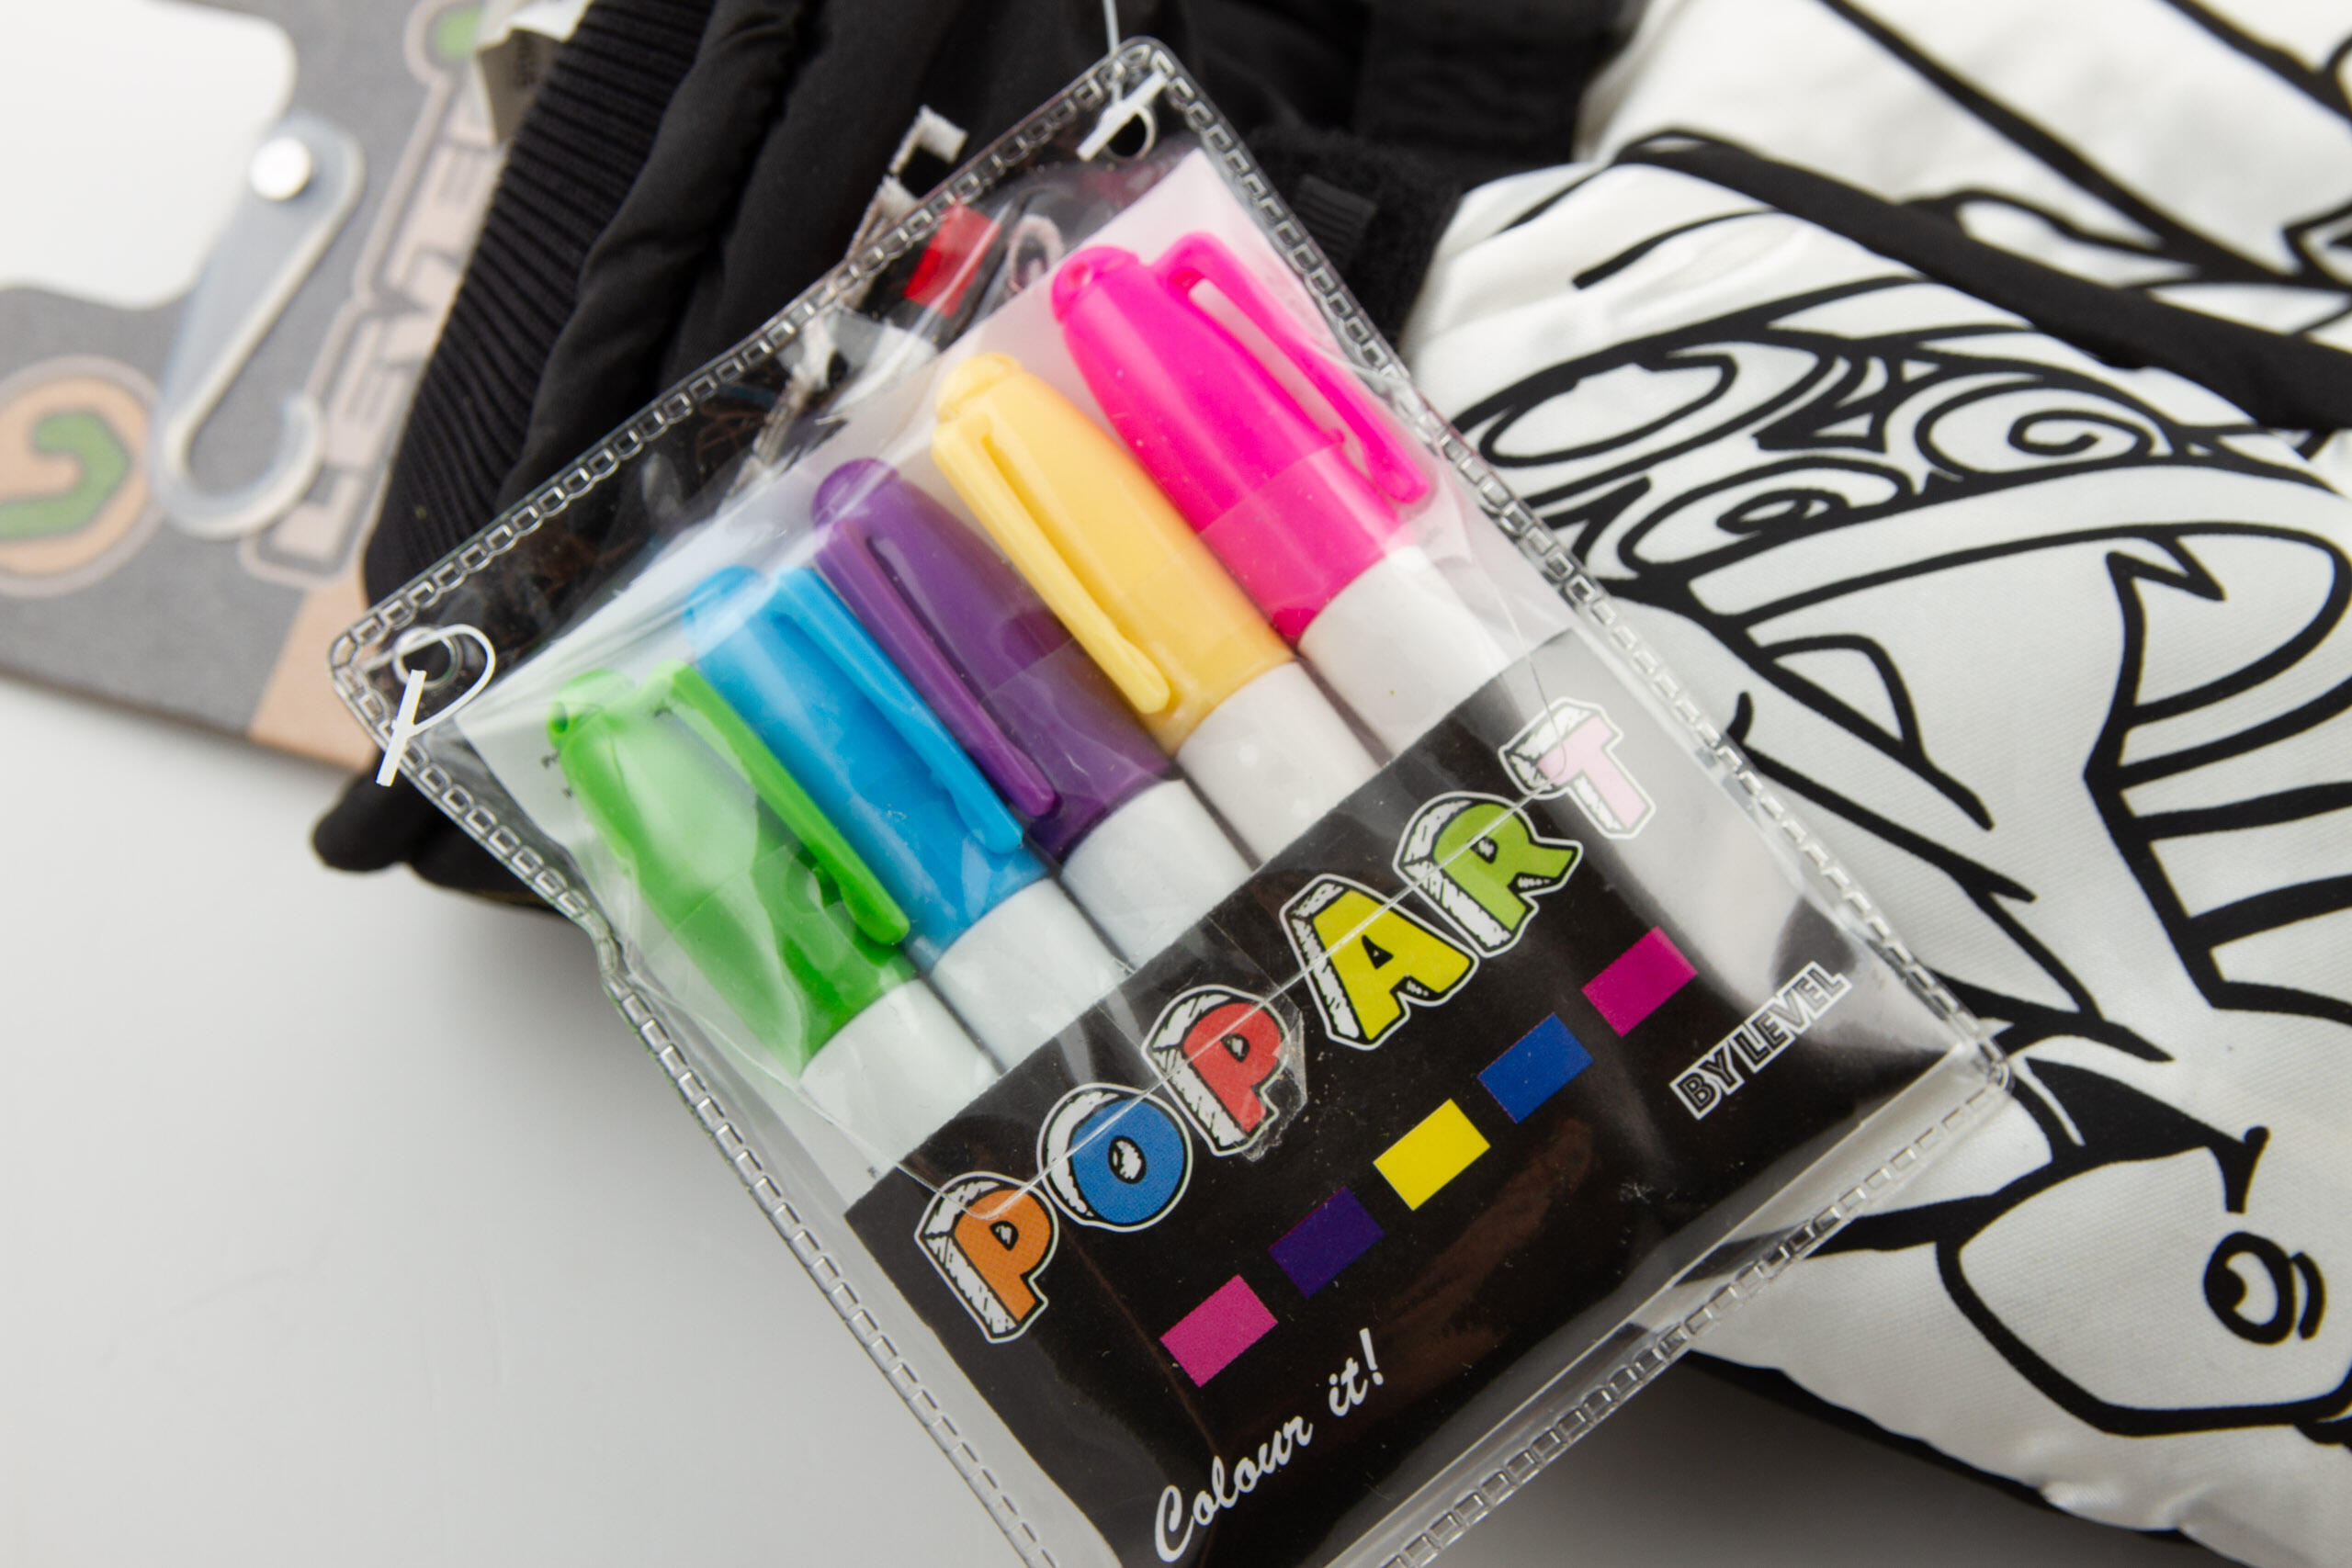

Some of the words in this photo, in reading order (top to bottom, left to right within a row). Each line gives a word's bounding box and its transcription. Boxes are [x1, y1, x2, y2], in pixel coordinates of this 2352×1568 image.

[915, 985, 1290, 1344] POP
[1281, 697, 1656, 1050] ART
[1668, 1037, 1745, 1121] BY
[1730, 961, 1853, 1075] LEVEL
[1154, 1416, 1314, 1562] Colour
[1328, 1327, 1385, 1416] it!
